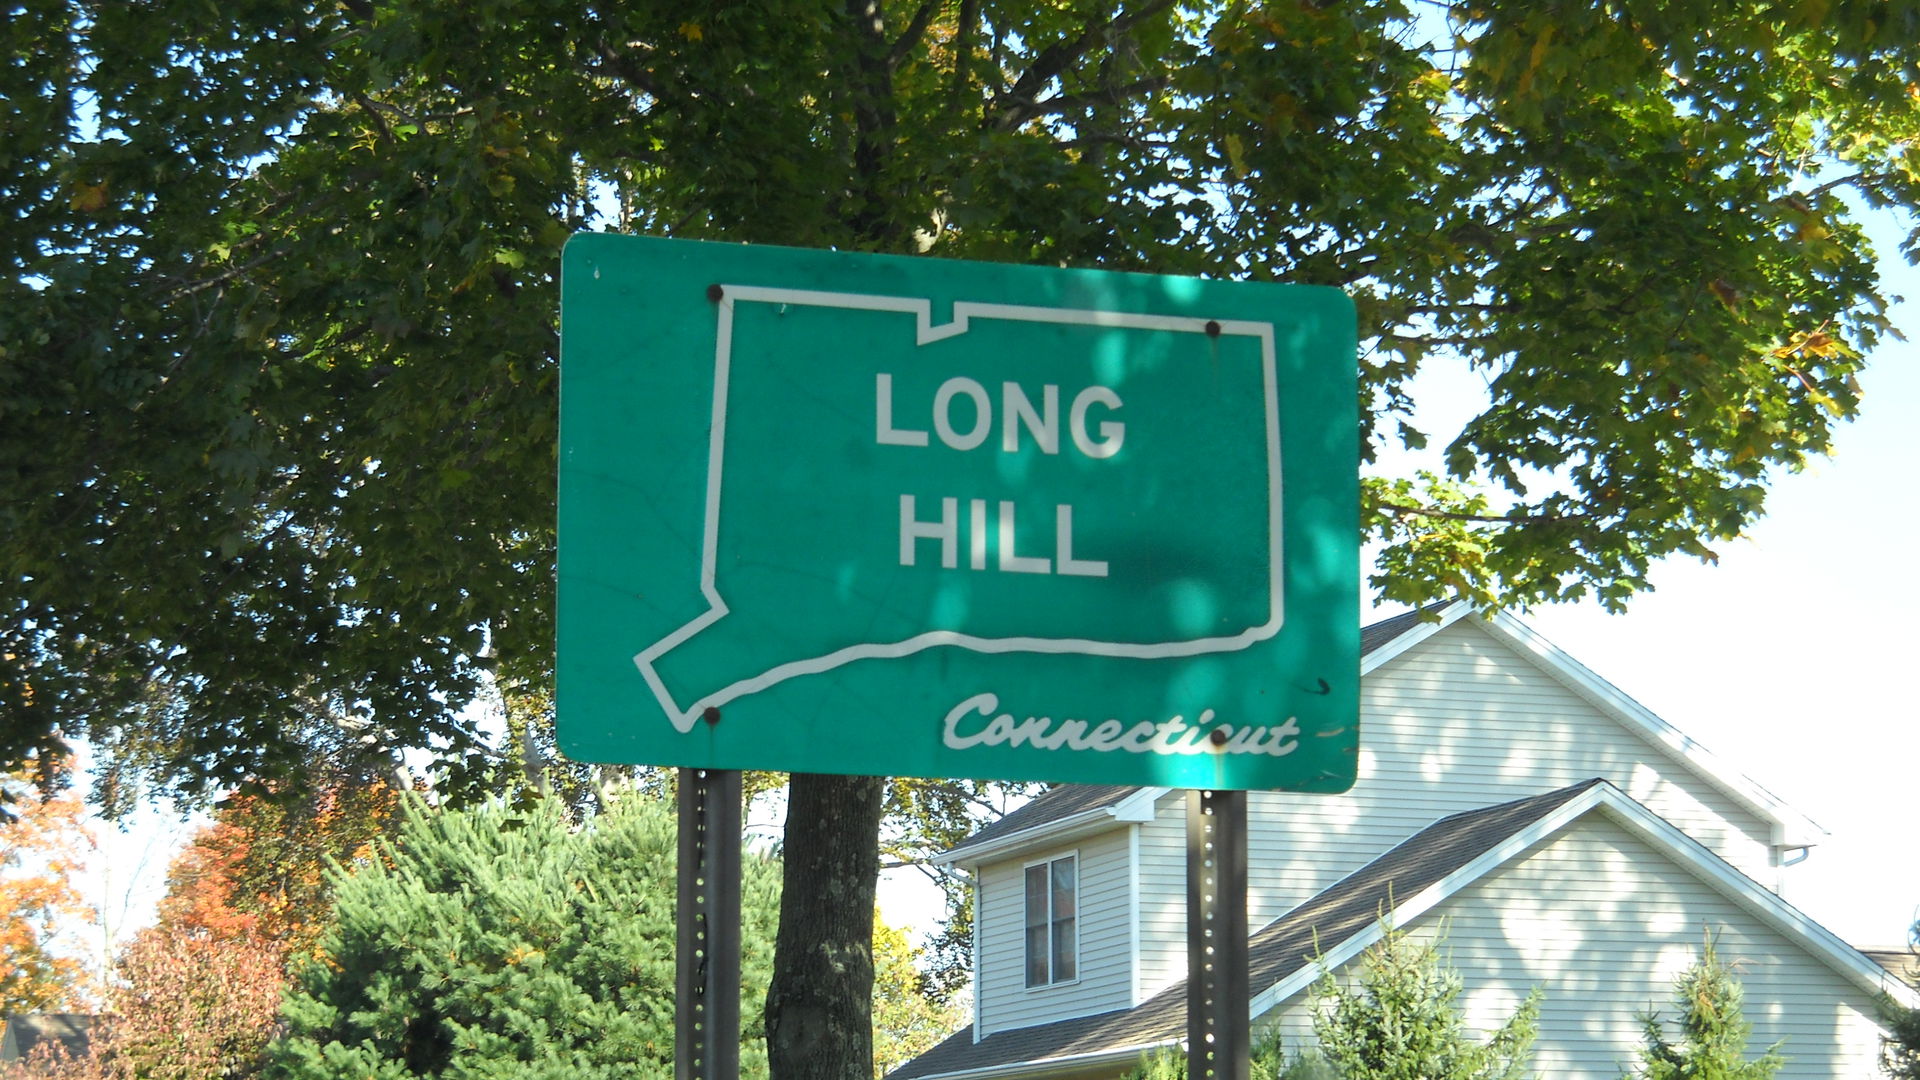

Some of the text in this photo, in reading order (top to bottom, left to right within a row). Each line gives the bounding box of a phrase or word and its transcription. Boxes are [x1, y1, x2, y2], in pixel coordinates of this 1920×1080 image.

[876, 373, 1124, 458] LONG
[900, 495, 1108, 577] HILL
[943, 692, 1299, 756] Connecticut
